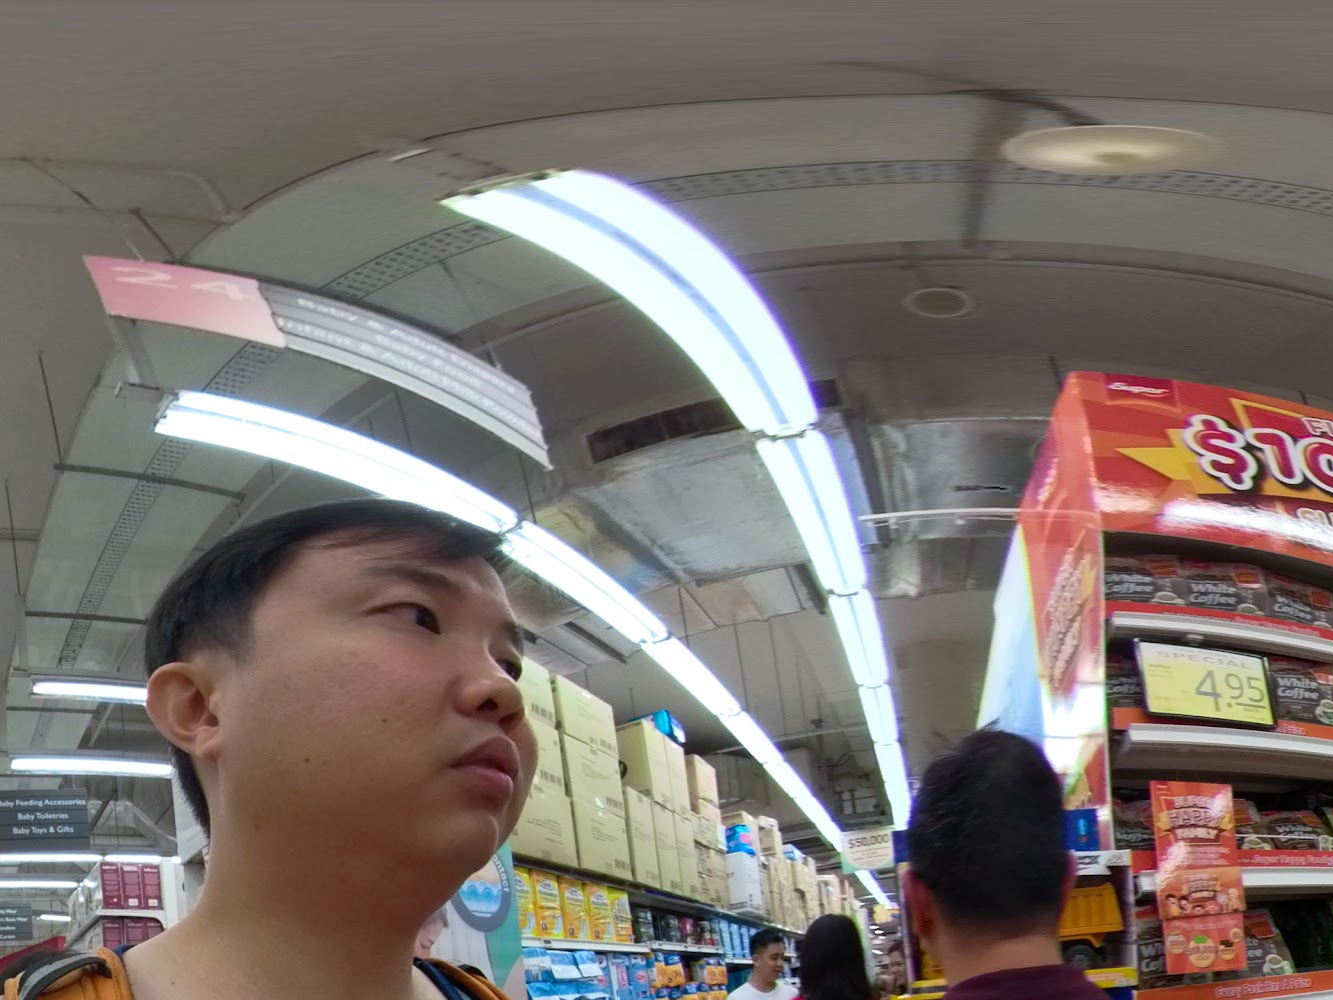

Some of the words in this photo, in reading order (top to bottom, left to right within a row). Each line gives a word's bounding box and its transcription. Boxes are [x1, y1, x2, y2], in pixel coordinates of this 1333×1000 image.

[1108, 381, 1169, 398] Super
[1191, 582, 1237, 594] White
[1189, 593, 1238, 605] Coffee
[1157, 650, 1252, 670] SPECIAL
[1277, 676, 1319, 688] White
[1195, 670, 1267, 712] 4.95
[1277, 687, 1320, 700] Coffee
[16, 799, 43, 807] Feeding
[18, 813, 35, 821] Baby
[13, 827, 29, 835] Baby
[32, 826, 47, 834] Toys
[1176, 828, 1218, 840] FAMILY
[1216, 984, 1243, 998] Every
[1244, 982, 1263, 995] Pack
